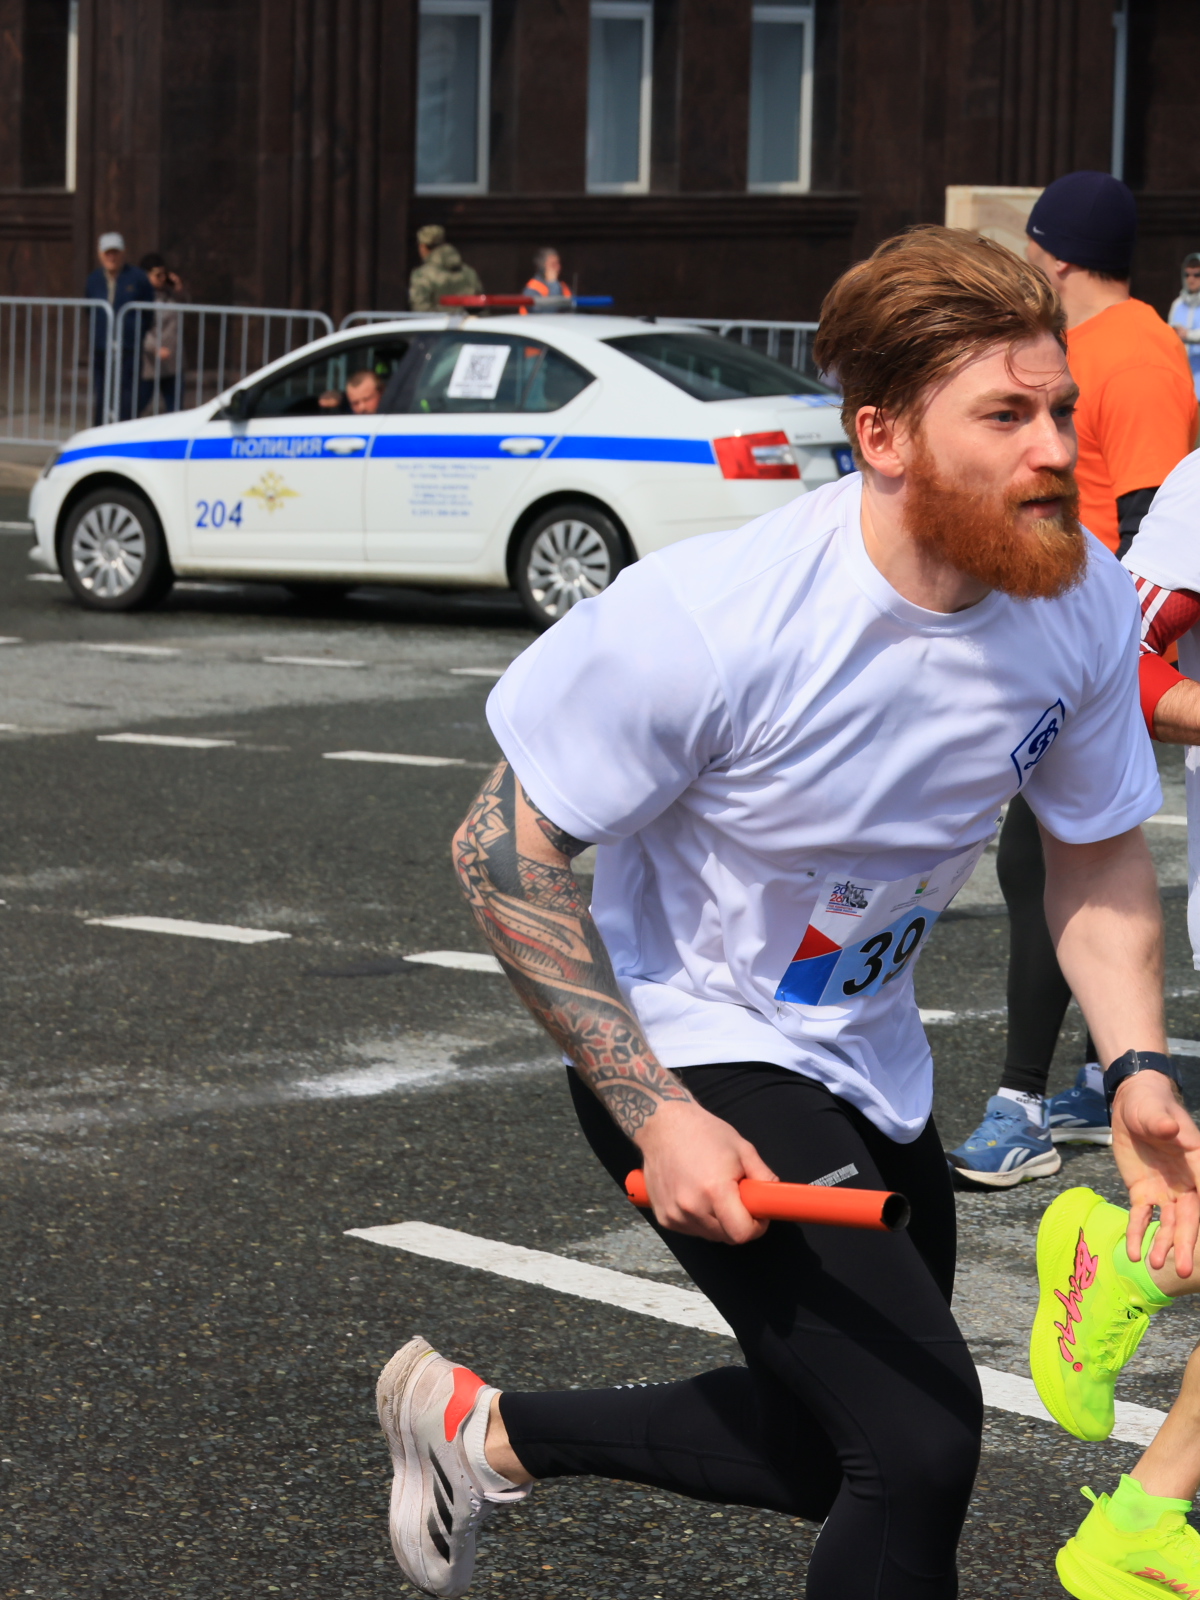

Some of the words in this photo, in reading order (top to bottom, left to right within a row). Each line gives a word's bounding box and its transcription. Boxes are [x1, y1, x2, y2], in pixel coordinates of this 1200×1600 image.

[231, 436, 322, 458] ПОЛИЦИЯ
[195, 500, 243, 529] 204
[829, 893, 843, 903] 26
[832, 885, 847, 895] 20
[842, 916, 926, 996] 39
